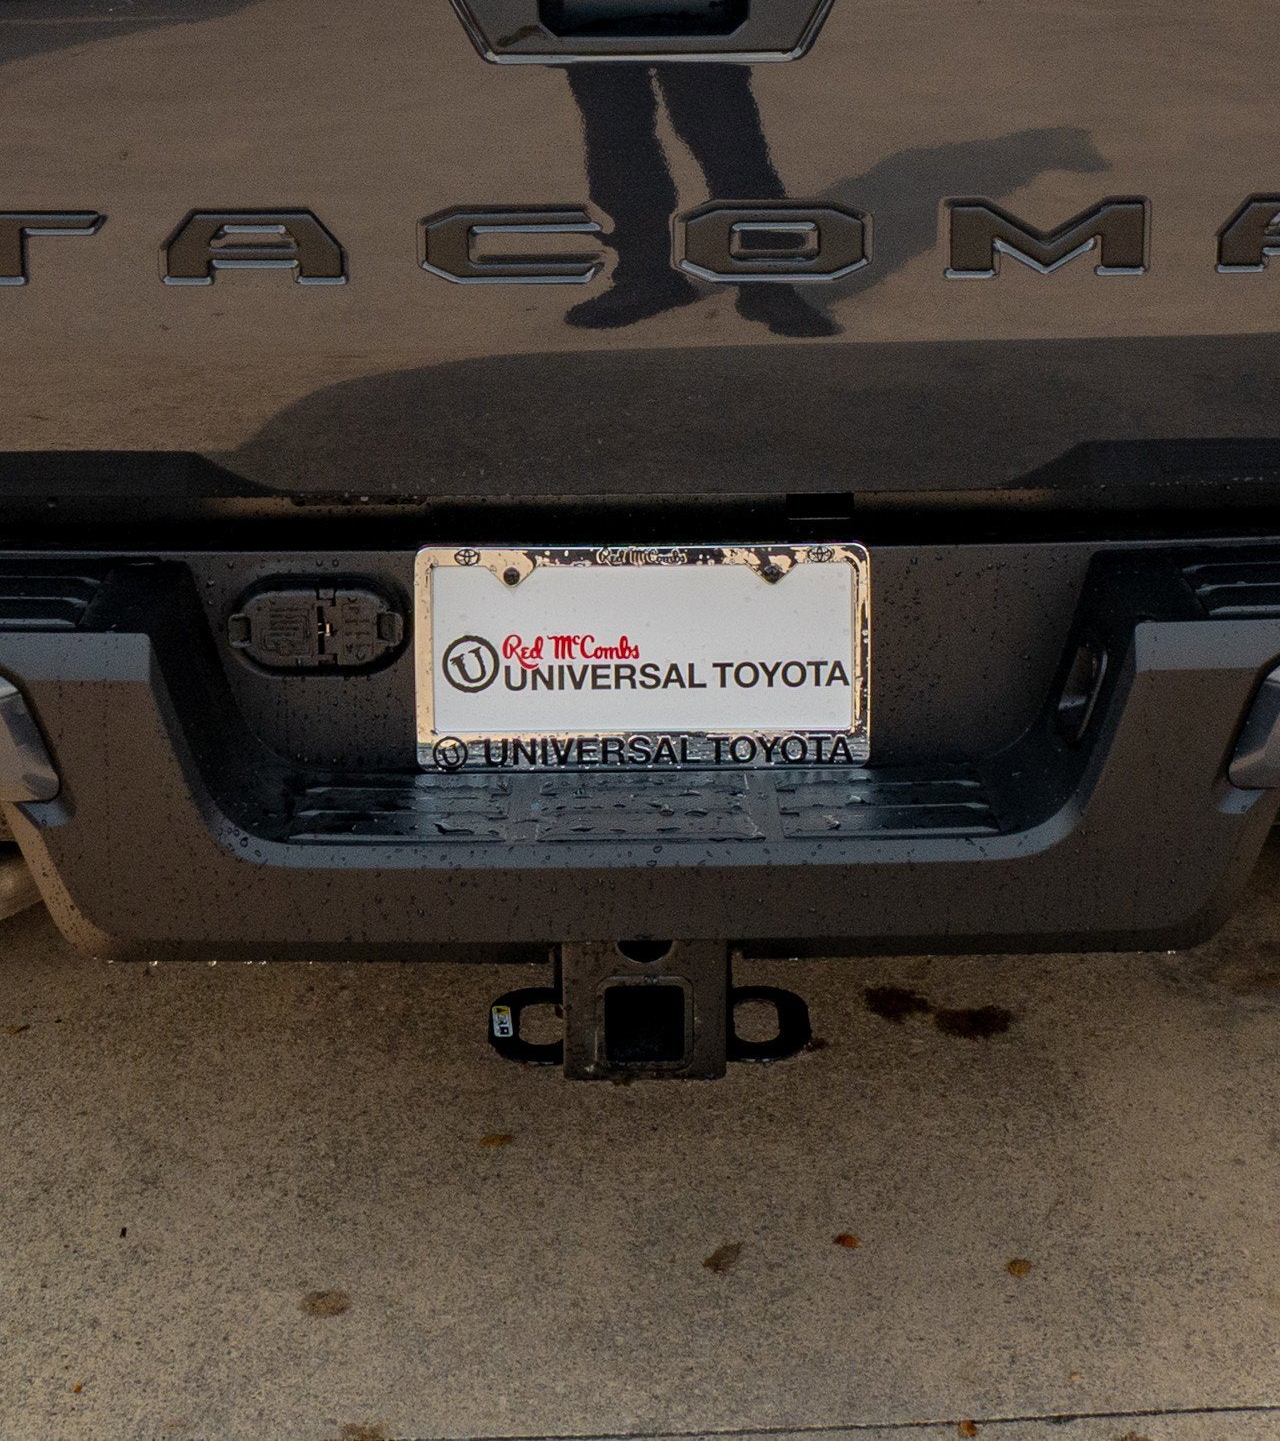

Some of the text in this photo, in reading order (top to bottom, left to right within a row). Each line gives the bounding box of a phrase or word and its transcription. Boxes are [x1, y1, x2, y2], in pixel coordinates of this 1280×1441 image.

[502, 634, 640, 669] Red McCombs
[503, 661, 707, 692] UNIVERSAL
[712, 660, 850, 689] TOYOTA
[483, 735, 702, 766] UNIVERSAL
[706, 734, 855, 764] TOYOTA
